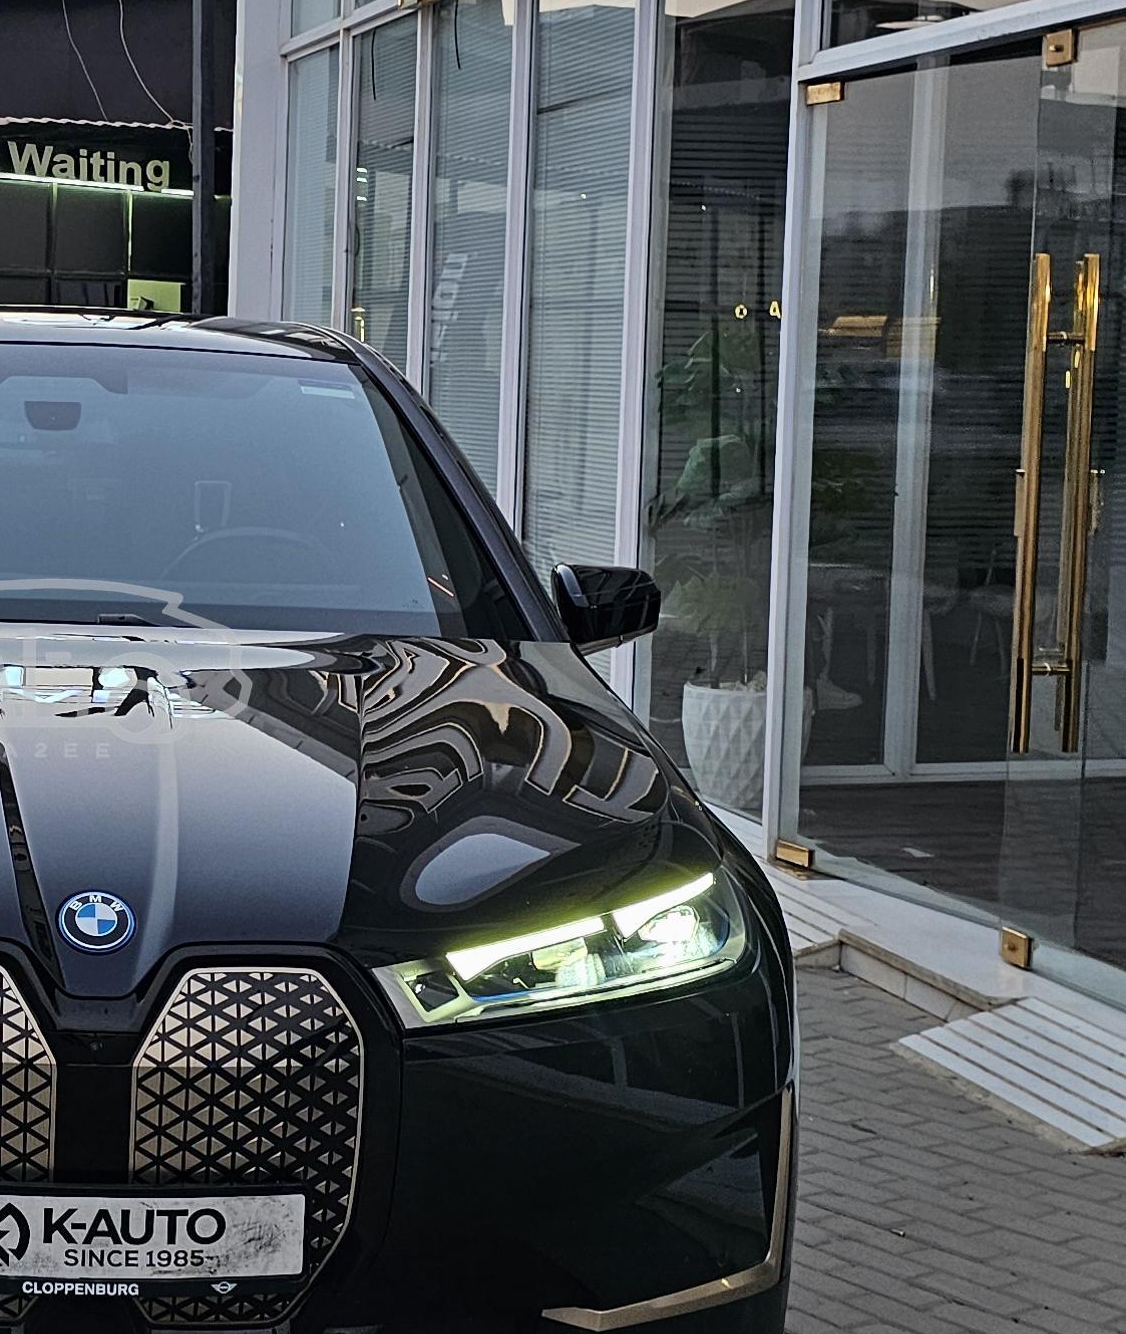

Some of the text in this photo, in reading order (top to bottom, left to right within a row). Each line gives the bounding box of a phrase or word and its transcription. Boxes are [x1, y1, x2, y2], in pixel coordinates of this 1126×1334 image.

[7, 140, 170, 192] Waiting
[68, 894, 125, 912] BMW
[43, 1207, 227, 1246] K-AUTO
[63, 1249, 140, 1268] SINCE
[21, 1280, 140, 1297] CLOPPENBURG
